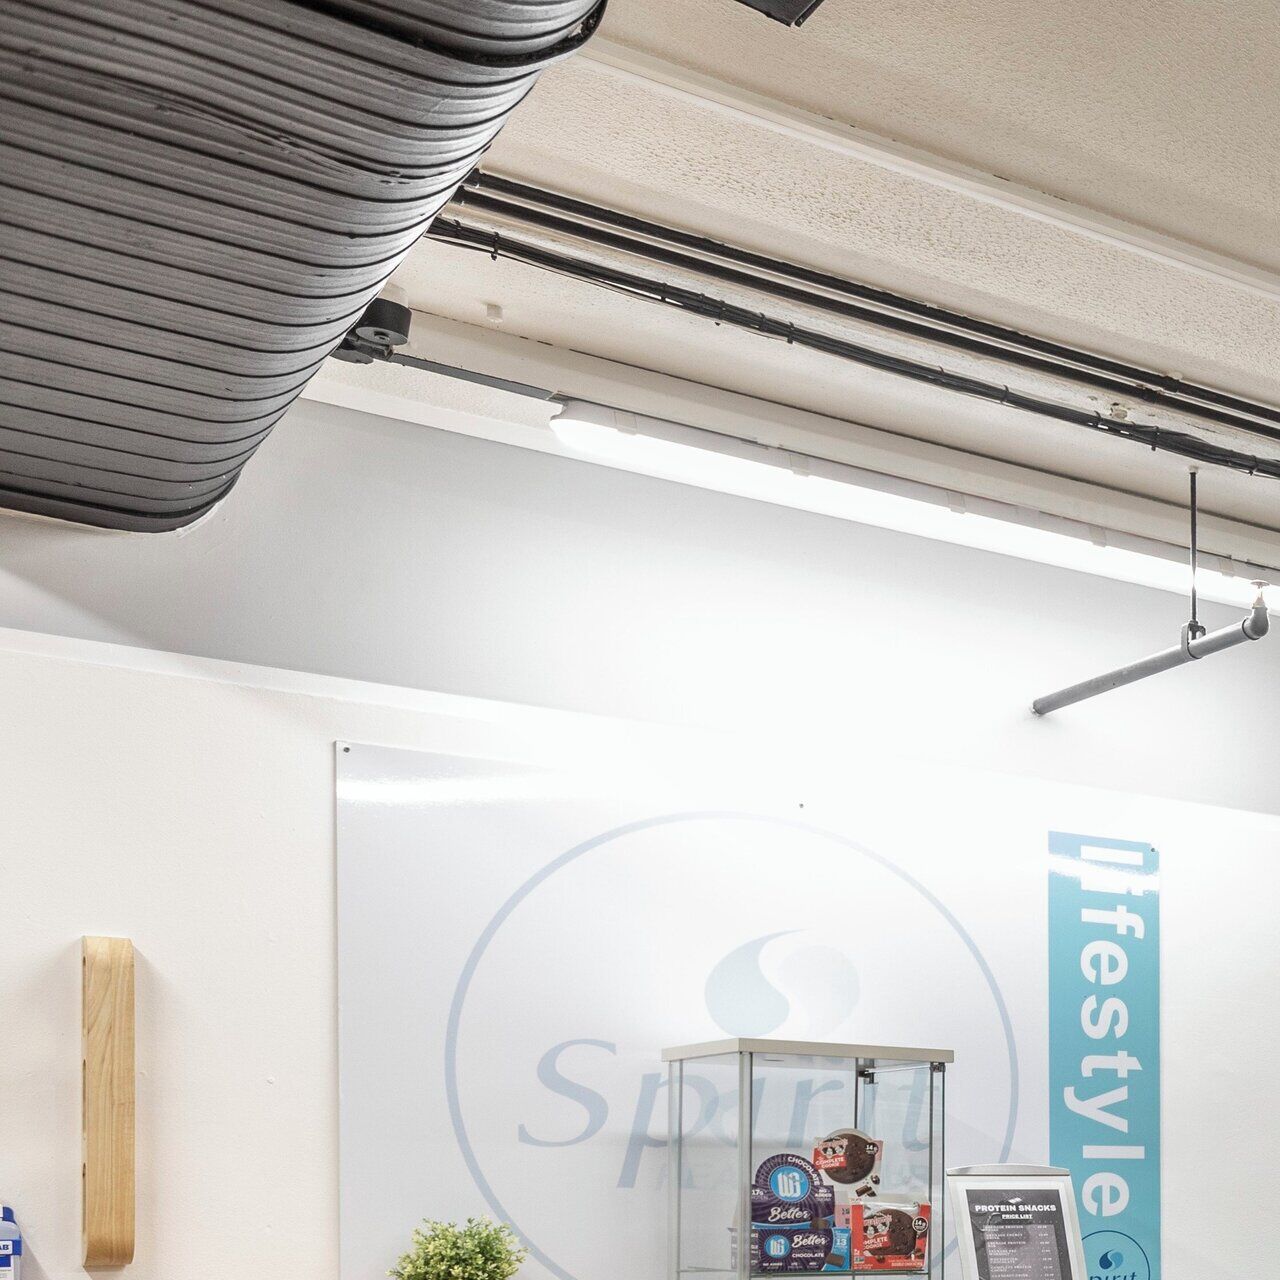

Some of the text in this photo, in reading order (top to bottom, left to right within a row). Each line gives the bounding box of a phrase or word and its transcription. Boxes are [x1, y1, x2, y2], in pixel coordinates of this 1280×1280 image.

[517, 1037, 942, 1189] Spirit
[786, 1155, 822, 1186] CHOCOLATE
[768, 1206, 812, 1222] Better
[974, 1204, 1017, 1212] PROTEIN
[791, 1234, 828, 1249] Better
